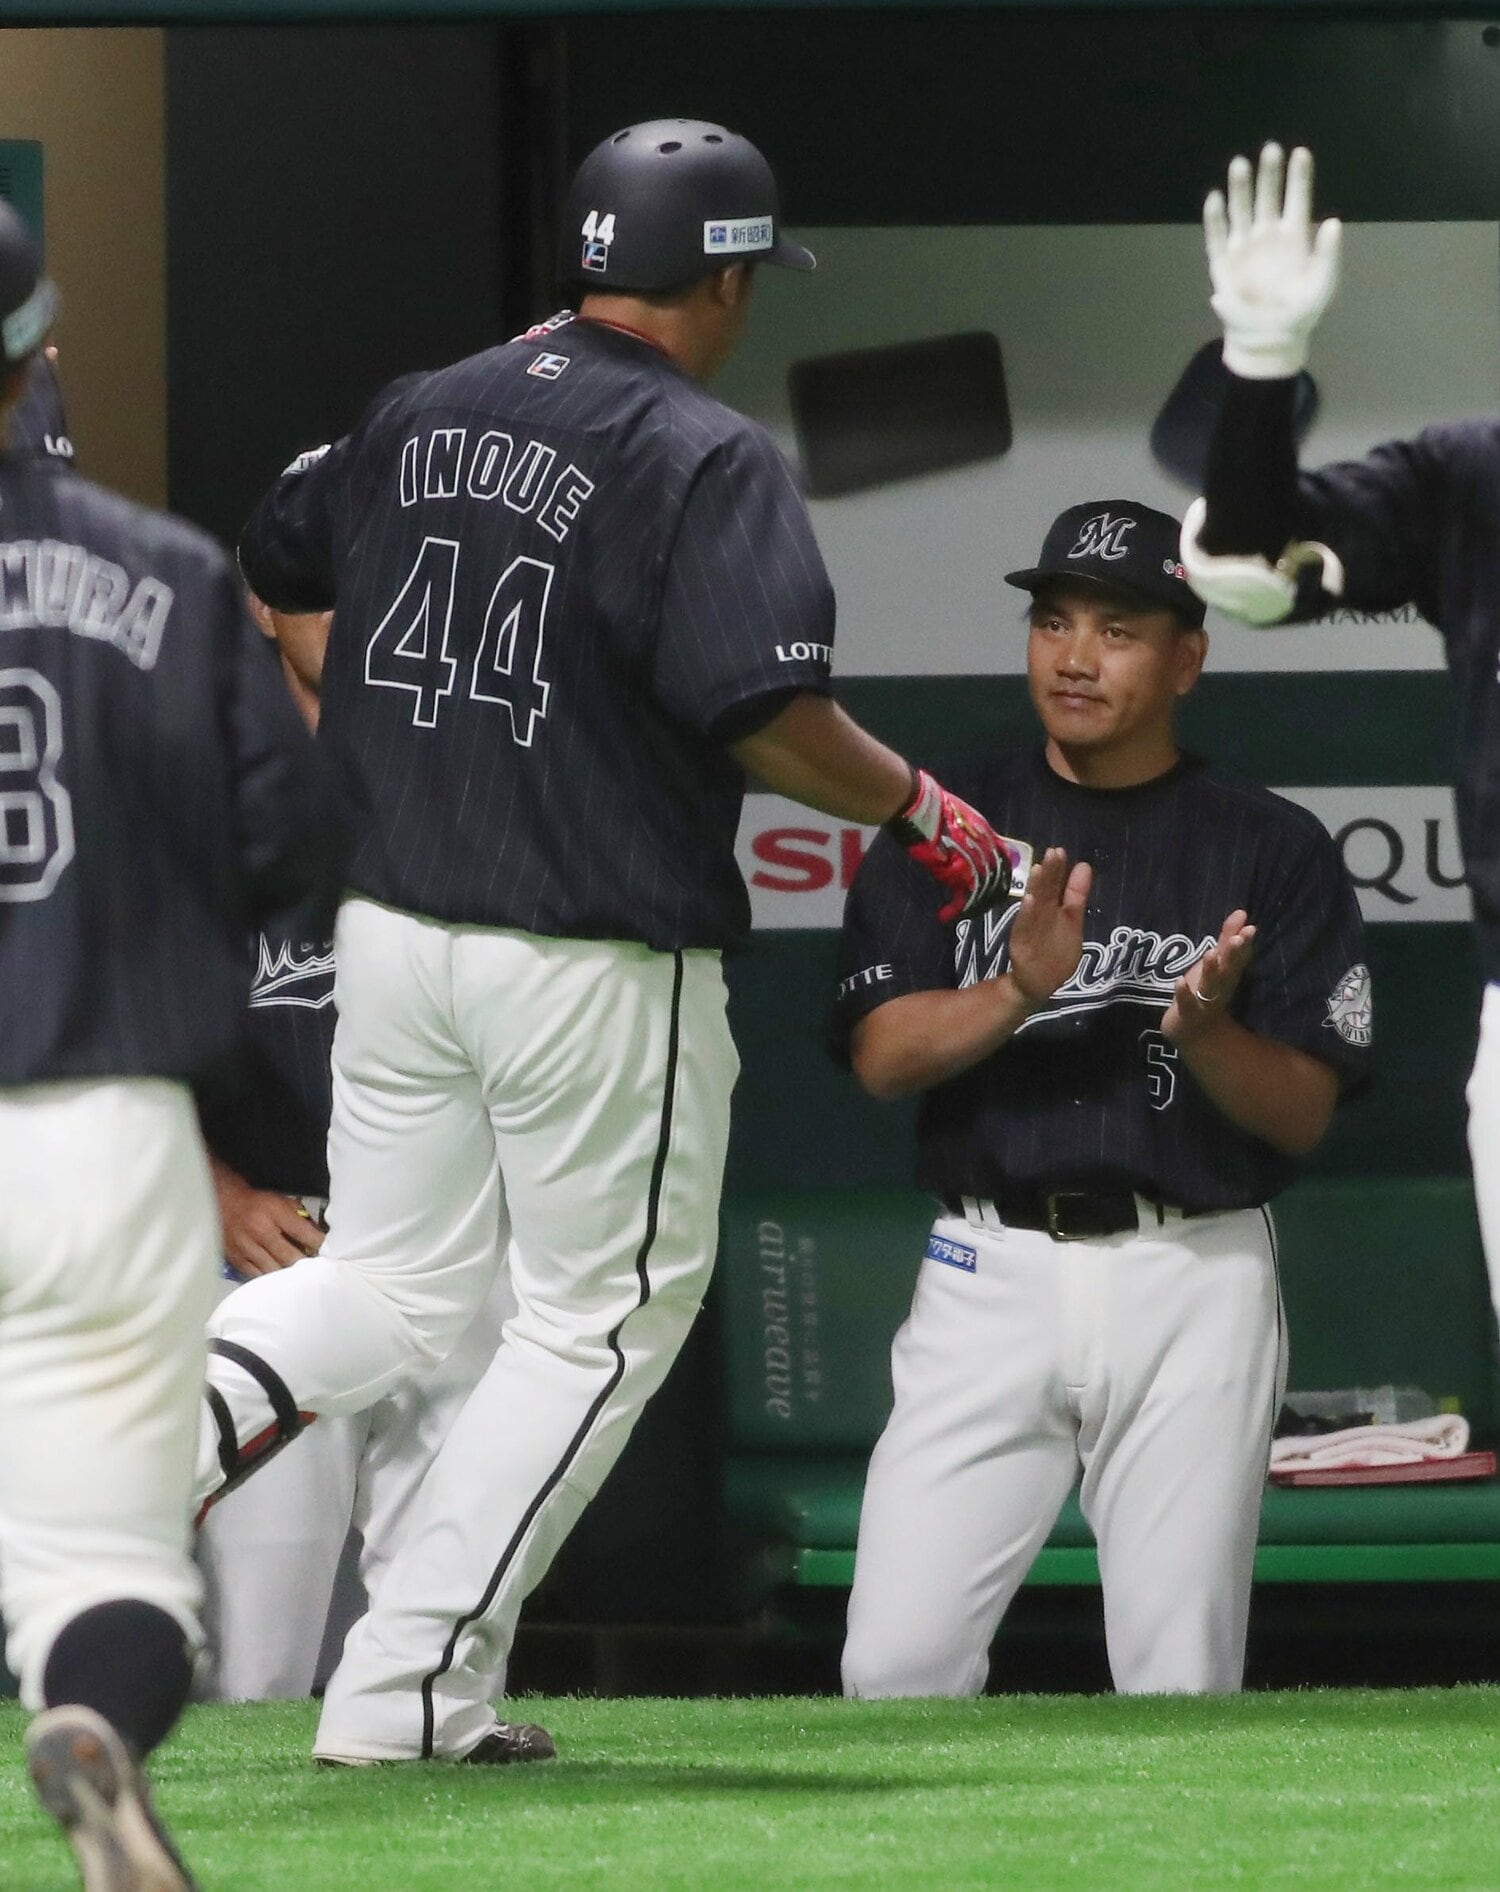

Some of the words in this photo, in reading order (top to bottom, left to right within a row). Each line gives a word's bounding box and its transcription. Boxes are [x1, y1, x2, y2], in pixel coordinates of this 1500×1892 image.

[581, 210, 616, 246] 44
[400, 428, 594, 543] INOUE
[1067, 512, 1137, 561] M
[365, 536, 555, 747] 44
[775, 641, 833, 662] LOTT
[0, 667, 75, 903] 8
